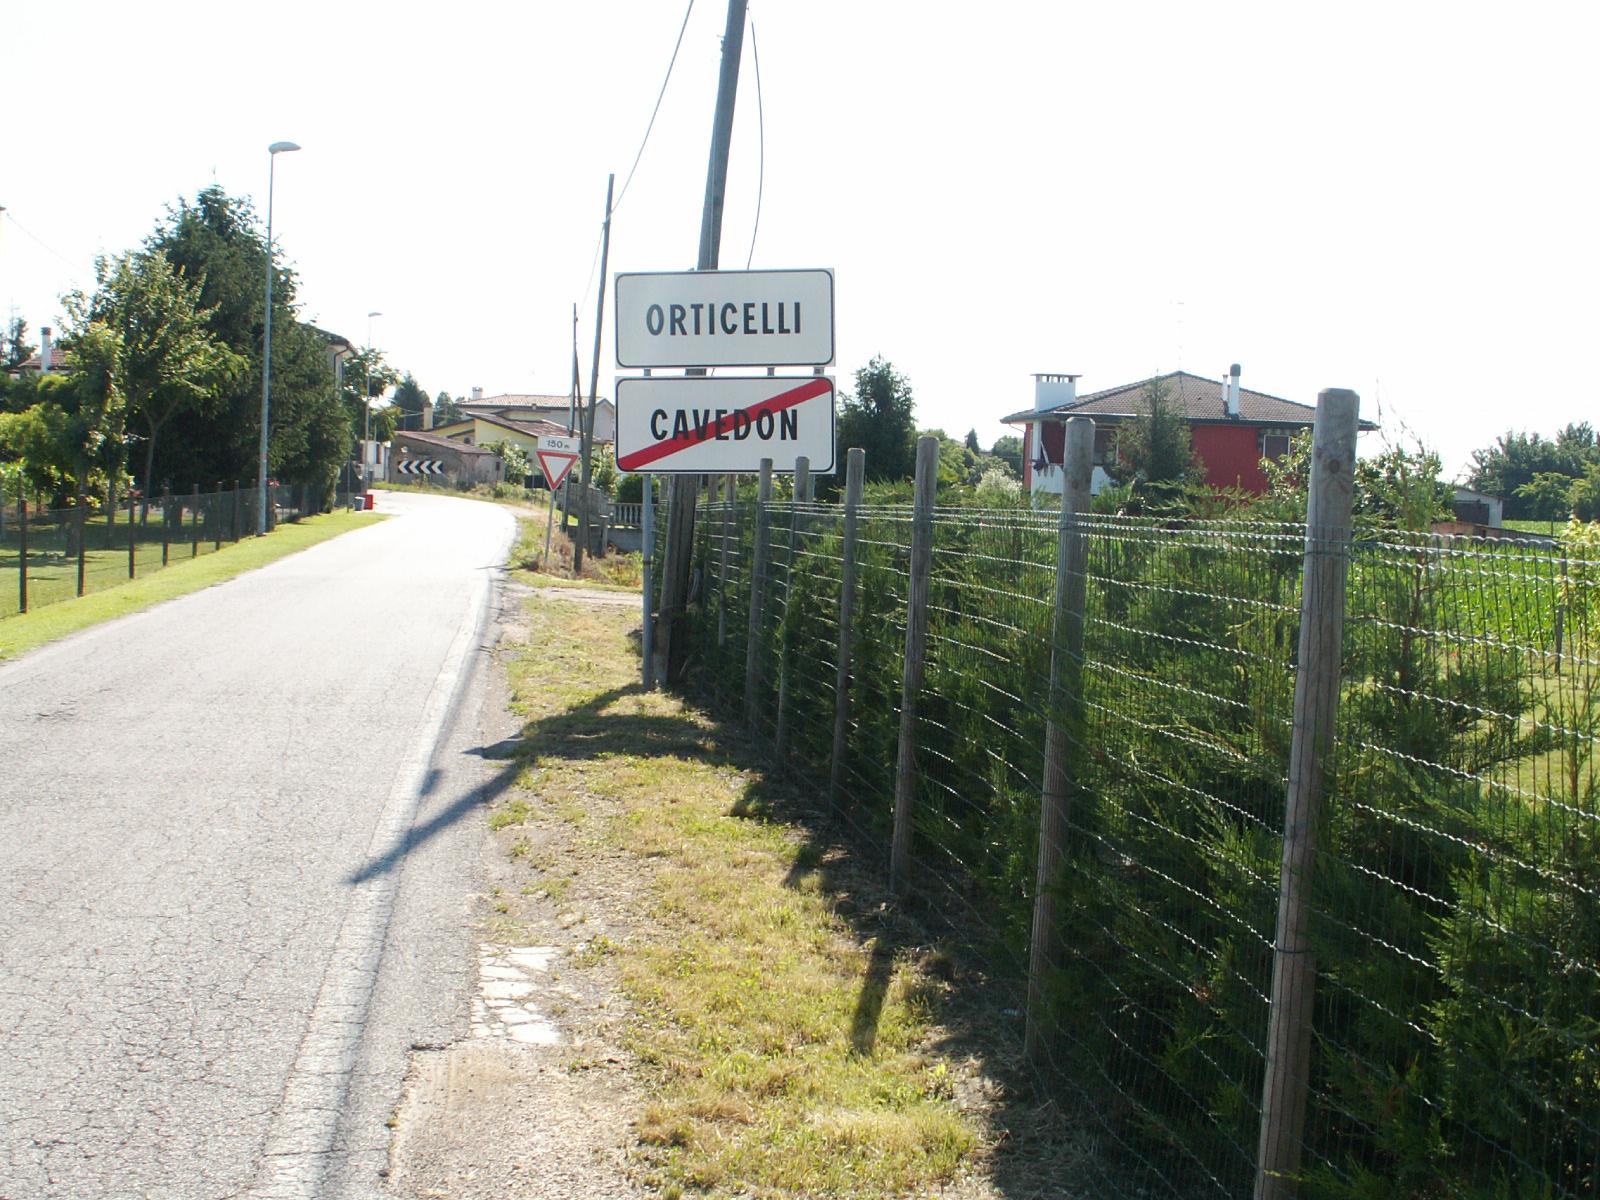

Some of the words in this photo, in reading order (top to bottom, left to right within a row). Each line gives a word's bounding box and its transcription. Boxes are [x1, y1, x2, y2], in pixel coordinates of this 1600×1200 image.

[646, 302, 801, 336] ORTICELLI
[650, 408, 798, 441] CAVEDON
[547, 440, 563, 448] 150
